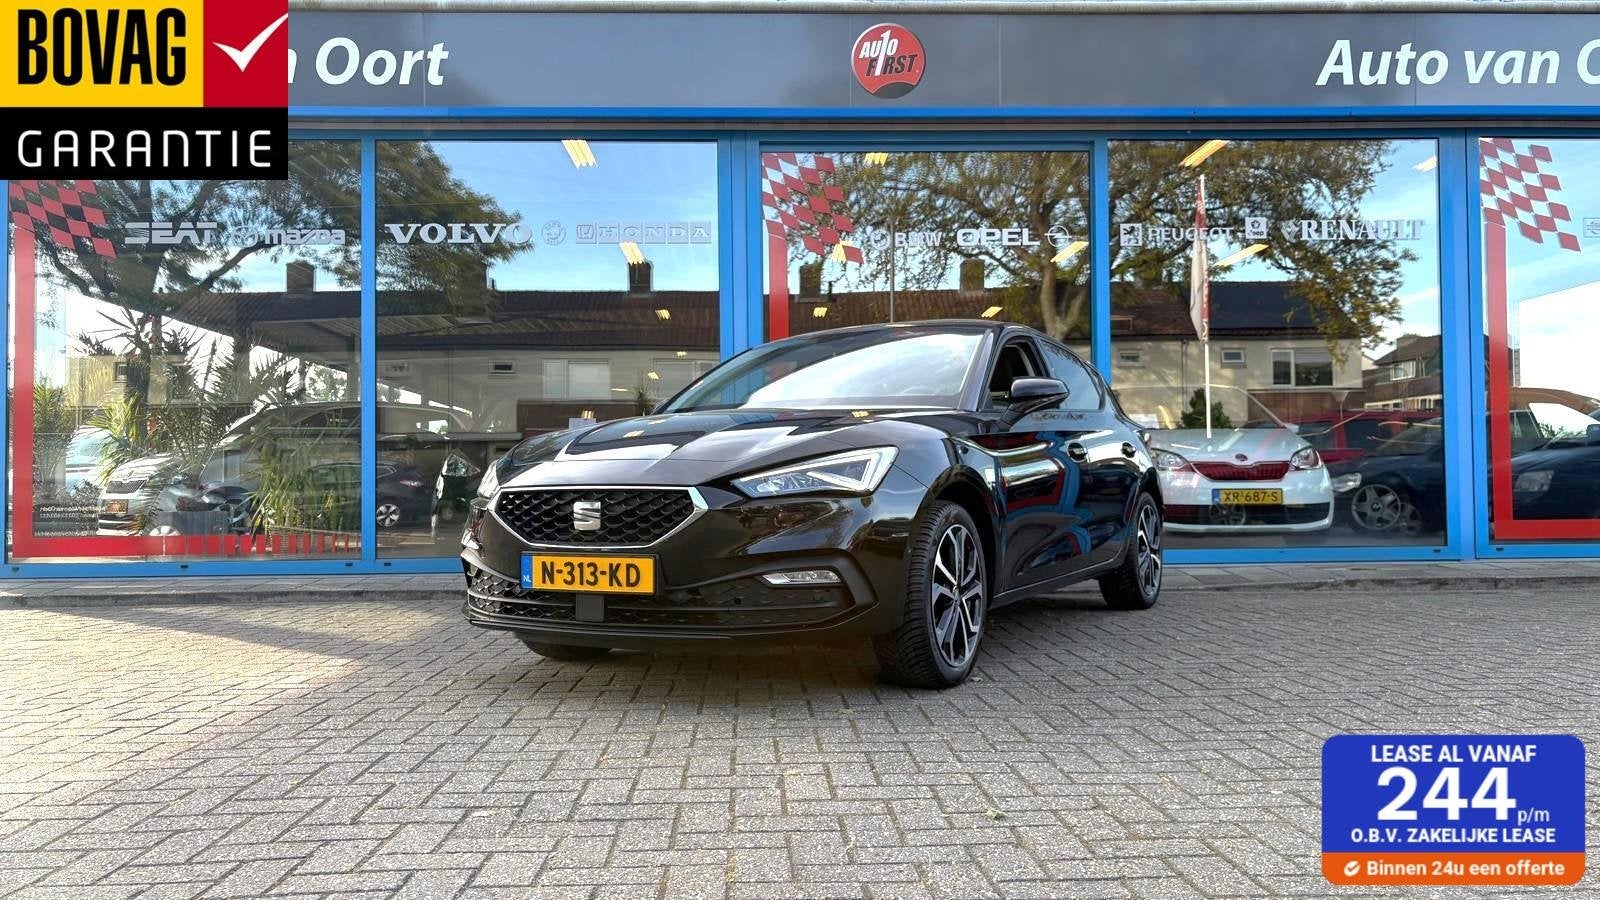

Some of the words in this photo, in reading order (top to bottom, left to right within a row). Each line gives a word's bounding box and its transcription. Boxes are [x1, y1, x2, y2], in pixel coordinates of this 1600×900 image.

[315, 37, 449, 86] Oort
[1315, 39, 1449, 85] Auto
[1464, 49, 1560, 84] van
[124, 221, 218, 244] SEAT
[384, 223, 533, 244] VOLVO
[599, 225, 710, 238] HONDA
[894, 231, 943, 247] BMW
[956, 228, 1041, 246] OPEL
[1148, 227, 1234, 242] PEUGEOT
[1299, 219, 1425, 241] RENAULT
[541, 560, 641, 588] N-313-KD
